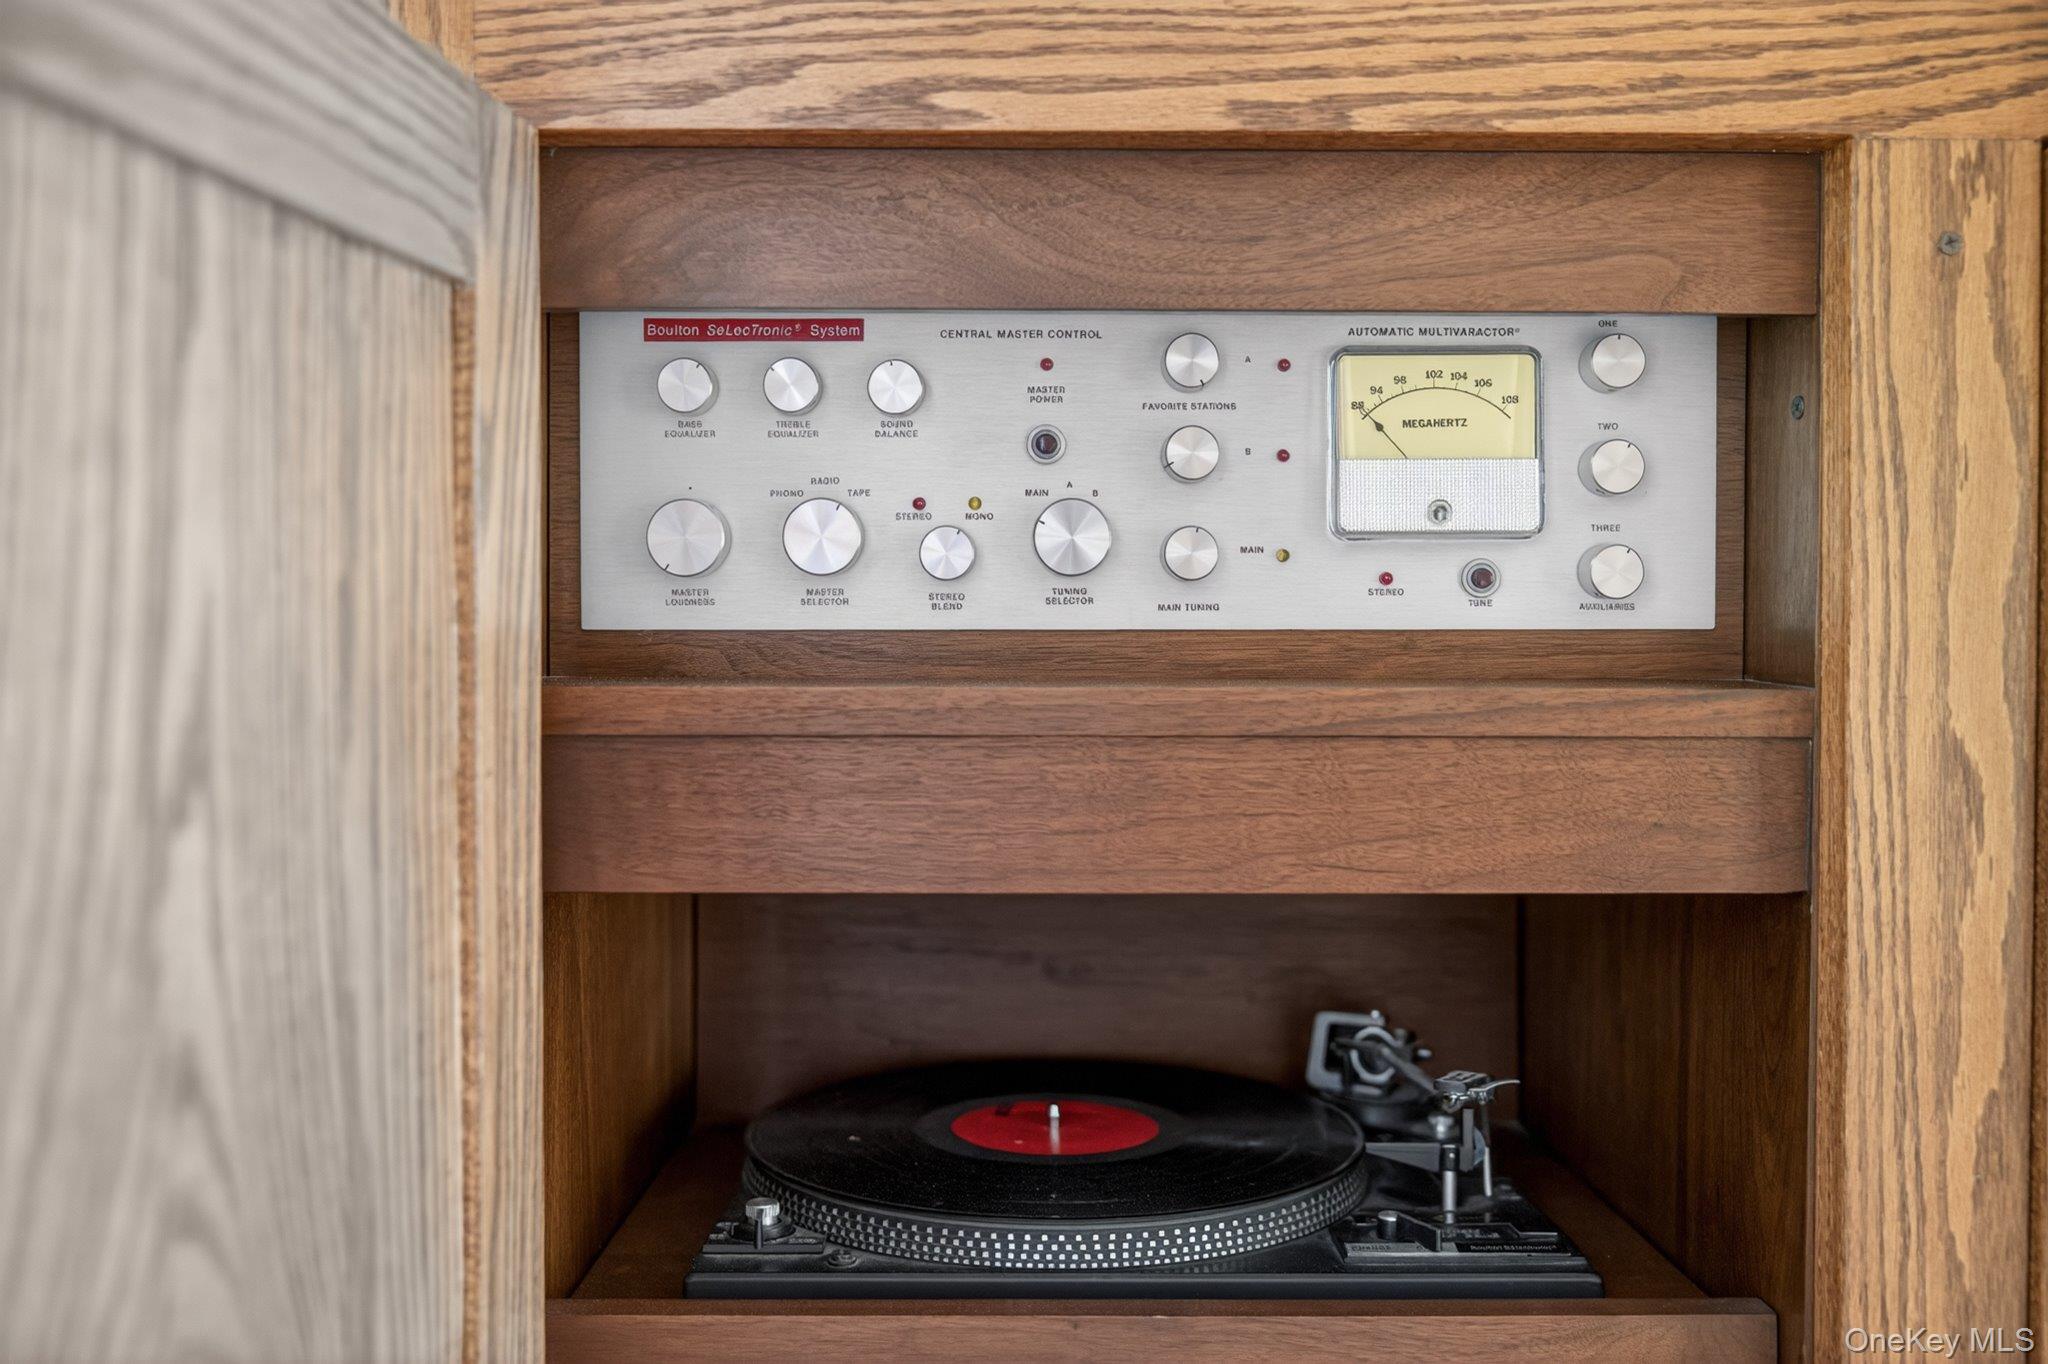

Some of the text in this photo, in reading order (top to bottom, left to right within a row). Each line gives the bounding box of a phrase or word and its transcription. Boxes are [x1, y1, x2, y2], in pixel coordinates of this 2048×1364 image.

[1598, 320, 1617, 328] ONE
[648, 324, 699, 335] Boulton
[811, 325, 860, 338] System
[940, 330, 1102, 339] CENTRAL MASTER CONTROL
[1348, 327, 1413, 336] AUTOMATIC
[1244, 356, 1252, 364] A
[1027, 386, 1065, 394] MASTER
[1370, 386, 1383, 395] 94
[1394, 376, 1407, 384] 98
[1425, 370, 1443, 379] 102
[1451, 372, 1468, 380] 104
[1475, 379, 1492, 387] 106
[1502, 395, 1519, 404] 108
[1030, 395, 1063, 403] POWER
[1142, 402, 1236, 411] FAVORITE STATIONS
[678, 420, 702, 428] BASS
[776, 421, 810, 429] TREBLE
[881, 420, 913, 428] SOUND
[1402, 418, 1467, 428] MEGAHERTZ
[1598, 423, 1618, 431] TWO
[665, 430, 715, 438] EQUALIZER
[768, 430, 819, 438] EQUALIZER
[875, 430, 918, 438] BALANCE
[1244, 448, 1252, 456] B
[811, 477, 840, 485] RADIO
[770, 490, 804, 498] PHONO
[848, 489, 870, 497] TAPE
[1025, 489, 1048, 497] MAIN
[1091, 490, 1099, 498] B
[896, 512, 932, 520] STEREO
[965, 513, 993, 521] MONO
[1591, 524, 1620, 532] THREE
[1240, 546, 1264, 554] MAIN
[672, 589, 709, 597] MASTER
[806, 588, 844, 596] MASTER
[1052, 588, 1087, 596] TUNING
[1368, 588, 1404, 596] STEREO
[929, 593, 965, 601] STEREO
[1046, 597, 1093, 605] SELECTOR
[665, 598, 715, 606] LOUDNESS
[801, 598, 849, 606] SELECTOR
[932, 602, 963, 610] BLEND
[1468, 599, 1492, 607] TUNE
[1158, 603, 1219, 612] MAIN TUNING
